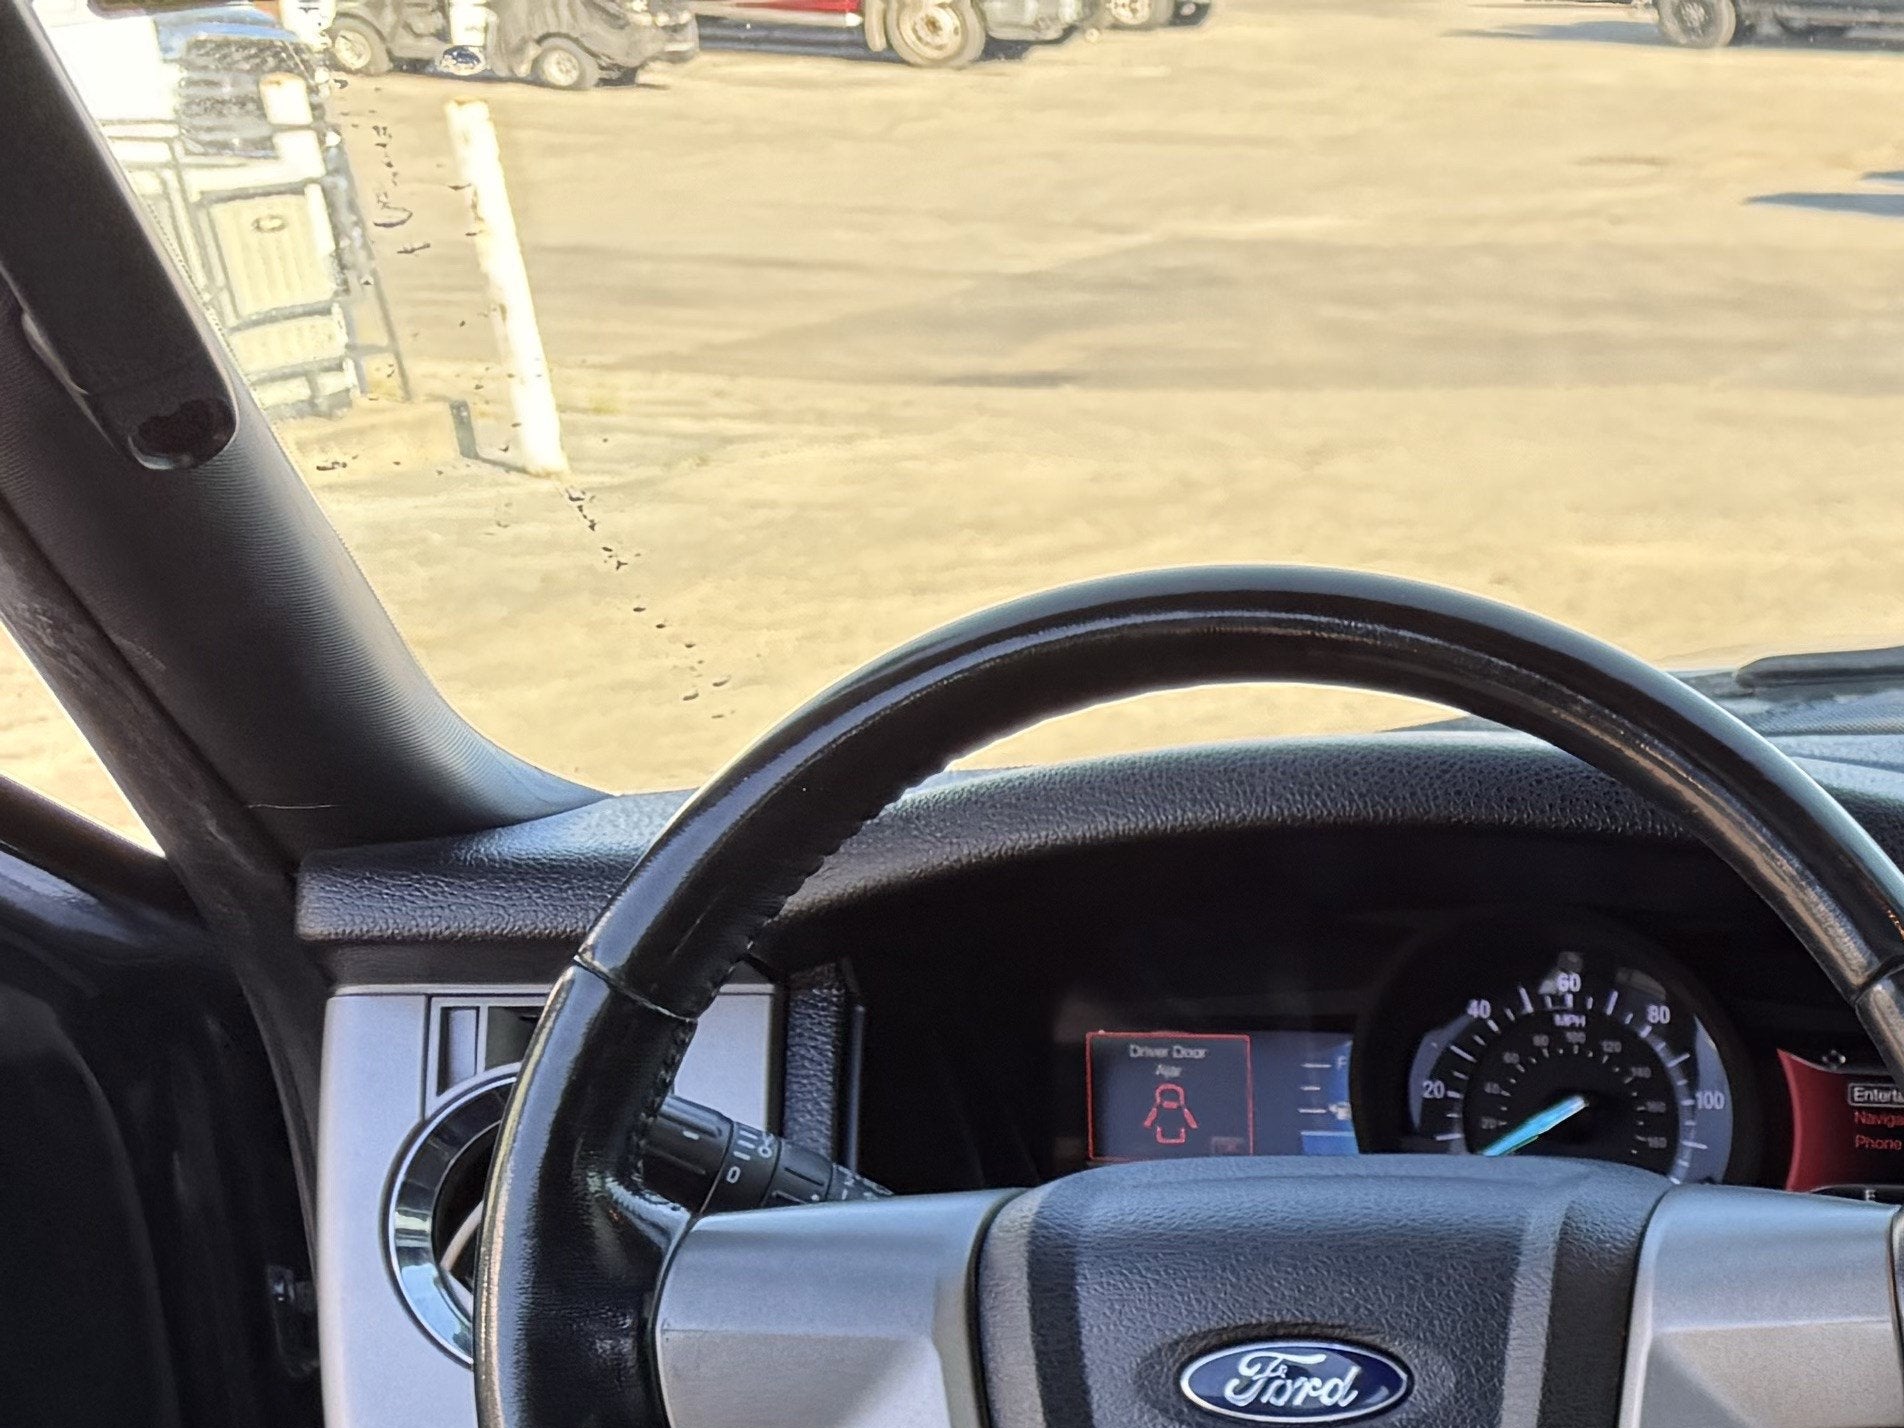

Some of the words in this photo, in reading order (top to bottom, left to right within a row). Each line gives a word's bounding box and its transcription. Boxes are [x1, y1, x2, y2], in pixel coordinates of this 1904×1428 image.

[1556, 972, 1581, 993] 60
[1467, 999, 1492, 1020] 40
[1647, 1004, 1671, 1025] 80
[1554, 1013, 1587, 1028] MPH
[1129, 1044, 1170, 1058] Driver
[1172, 1045, 1208, 1059] Door
[1422, 1080, 1445, 1099] 20
[1696, 1090, 1725, 1110] 100
[1855, 1135, 1902, 1150] Phone
[1224, 1351, 1362, 1407] Ford
